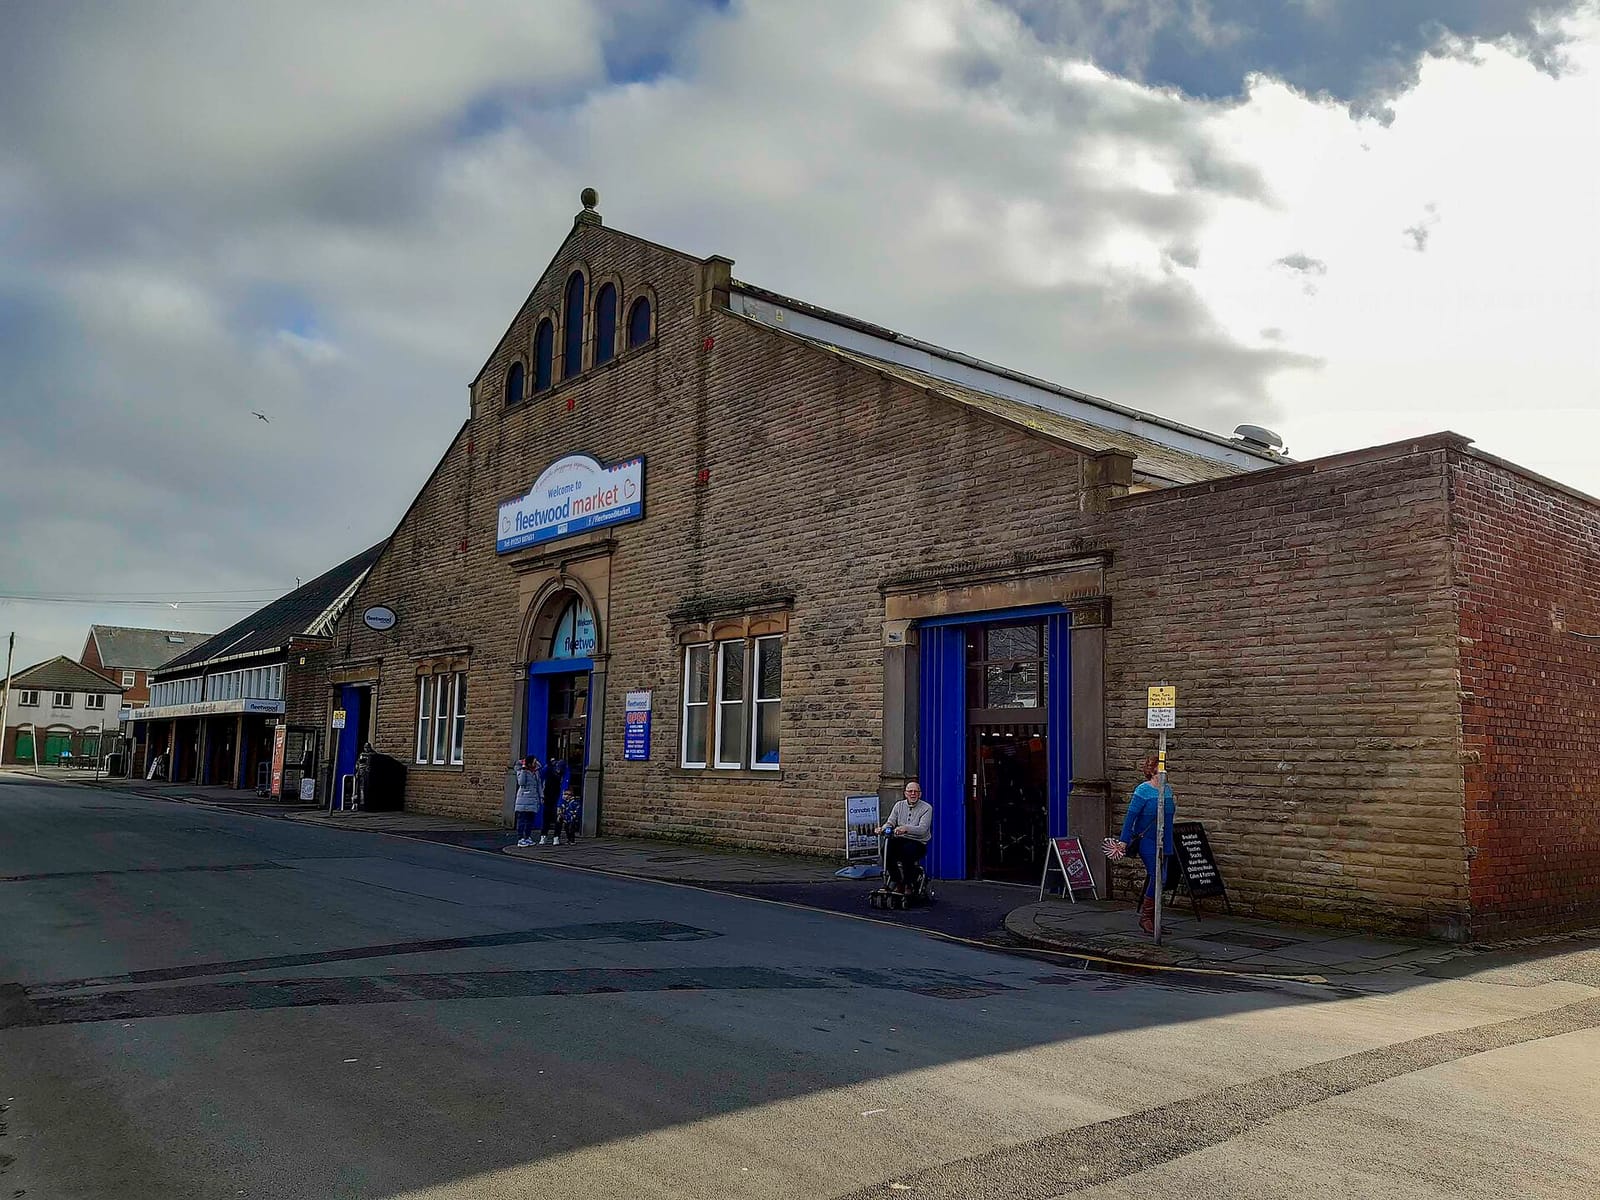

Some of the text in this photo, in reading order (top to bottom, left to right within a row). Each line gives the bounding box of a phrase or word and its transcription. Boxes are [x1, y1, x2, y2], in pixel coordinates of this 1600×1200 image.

[547, 479, 582, 499] Welcome to
[515, 484, 619, 532] fleetwood market
[564, 636, 594, 651] fleetwo
[250, 703, 279, 712] fleetwood
[626, 711, 647, 724] OPEN
